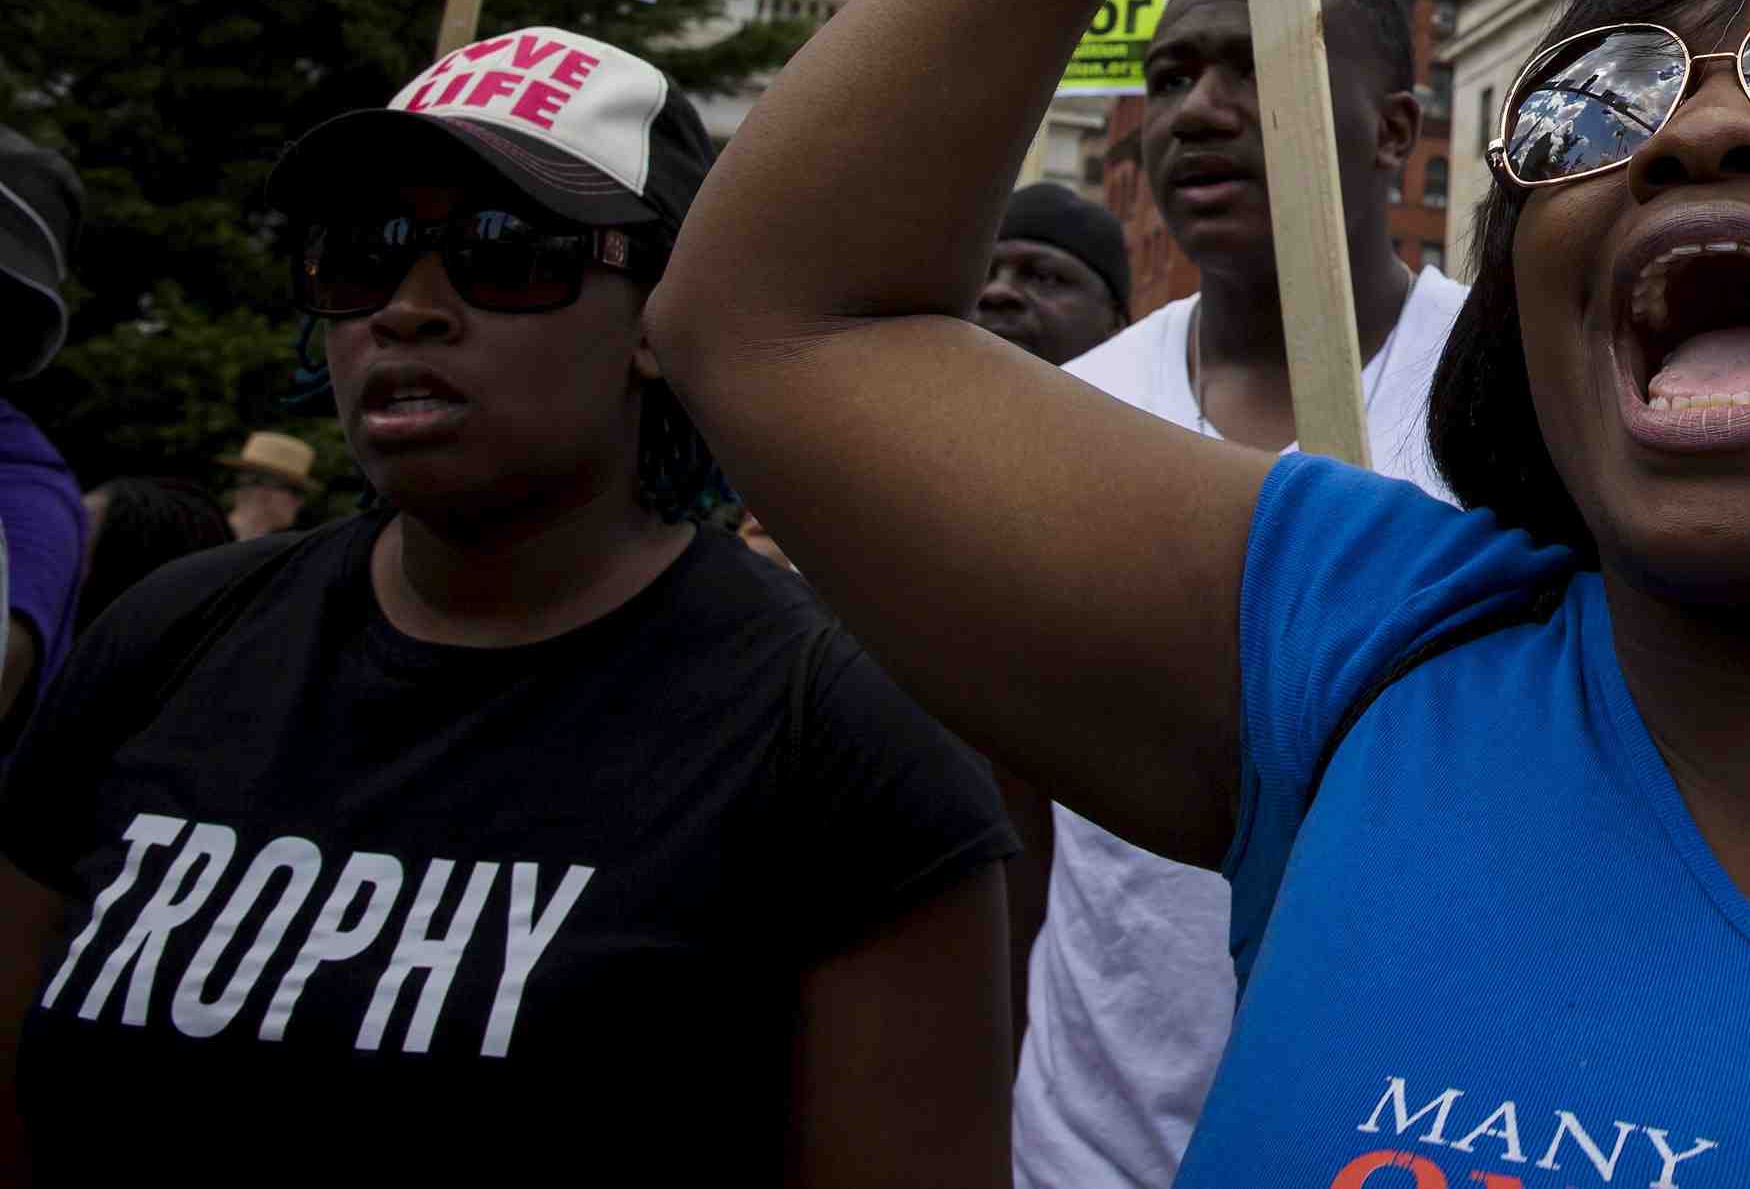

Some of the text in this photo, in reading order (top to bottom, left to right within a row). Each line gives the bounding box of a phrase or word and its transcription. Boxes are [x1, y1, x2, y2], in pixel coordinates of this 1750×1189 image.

[404, 70, 572, 130] LIFE
[41, 813, 596, 1058] TROPHY
[1357, 1077, 1717, 1189] MANY
